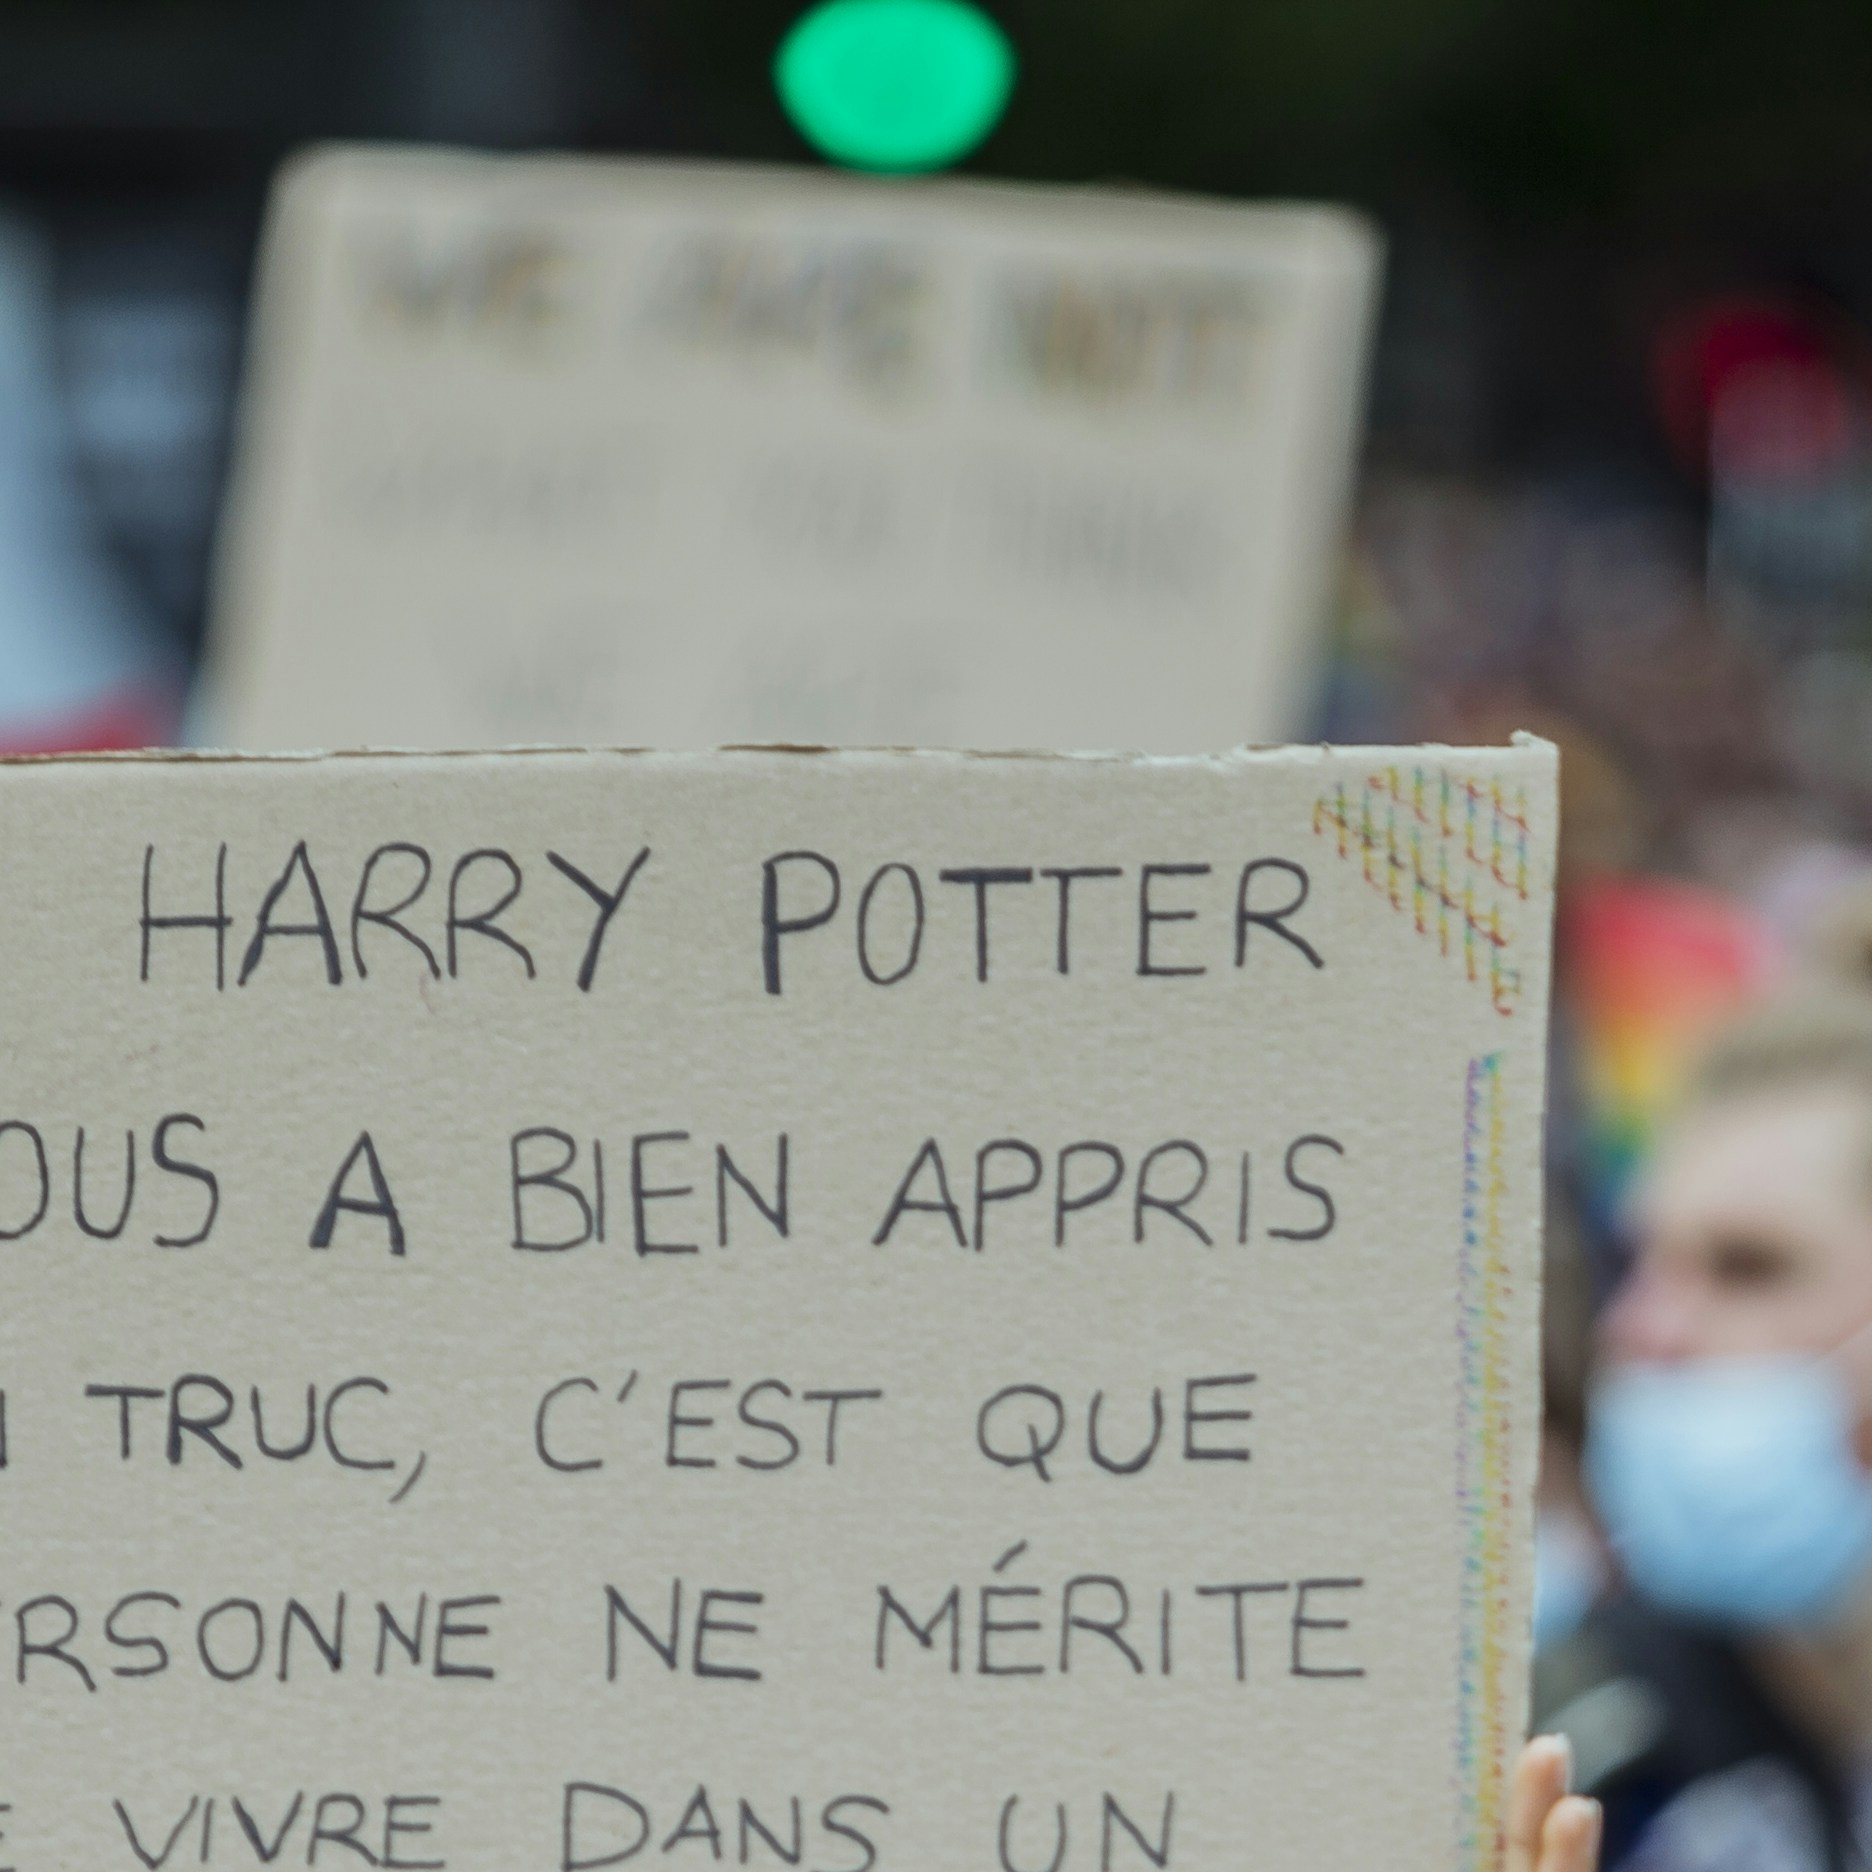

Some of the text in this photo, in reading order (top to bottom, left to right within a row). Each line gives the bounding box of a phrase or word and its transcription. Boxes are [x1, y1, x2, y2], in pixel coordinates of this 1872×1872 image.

[138, 838, 652, 994] HARRY
[760, 849, 1326, 997] POTTER
[307, 1129, 408, 1259] A
[509, 1125, 791, 1259] BIEN
[870, 1133, 1345, 1253] APPRIS
[83, 1372, 427, 1503] TRUC,
[534, 1370, 884, 1474] C'EST
[976, 1372, 1258, 1484] QUE
[603, 1578, 765, 1683] NE
[874, 1540, 1366, 1682] MÉRITE
[112, 1790, 446, 1872] VIVRE
